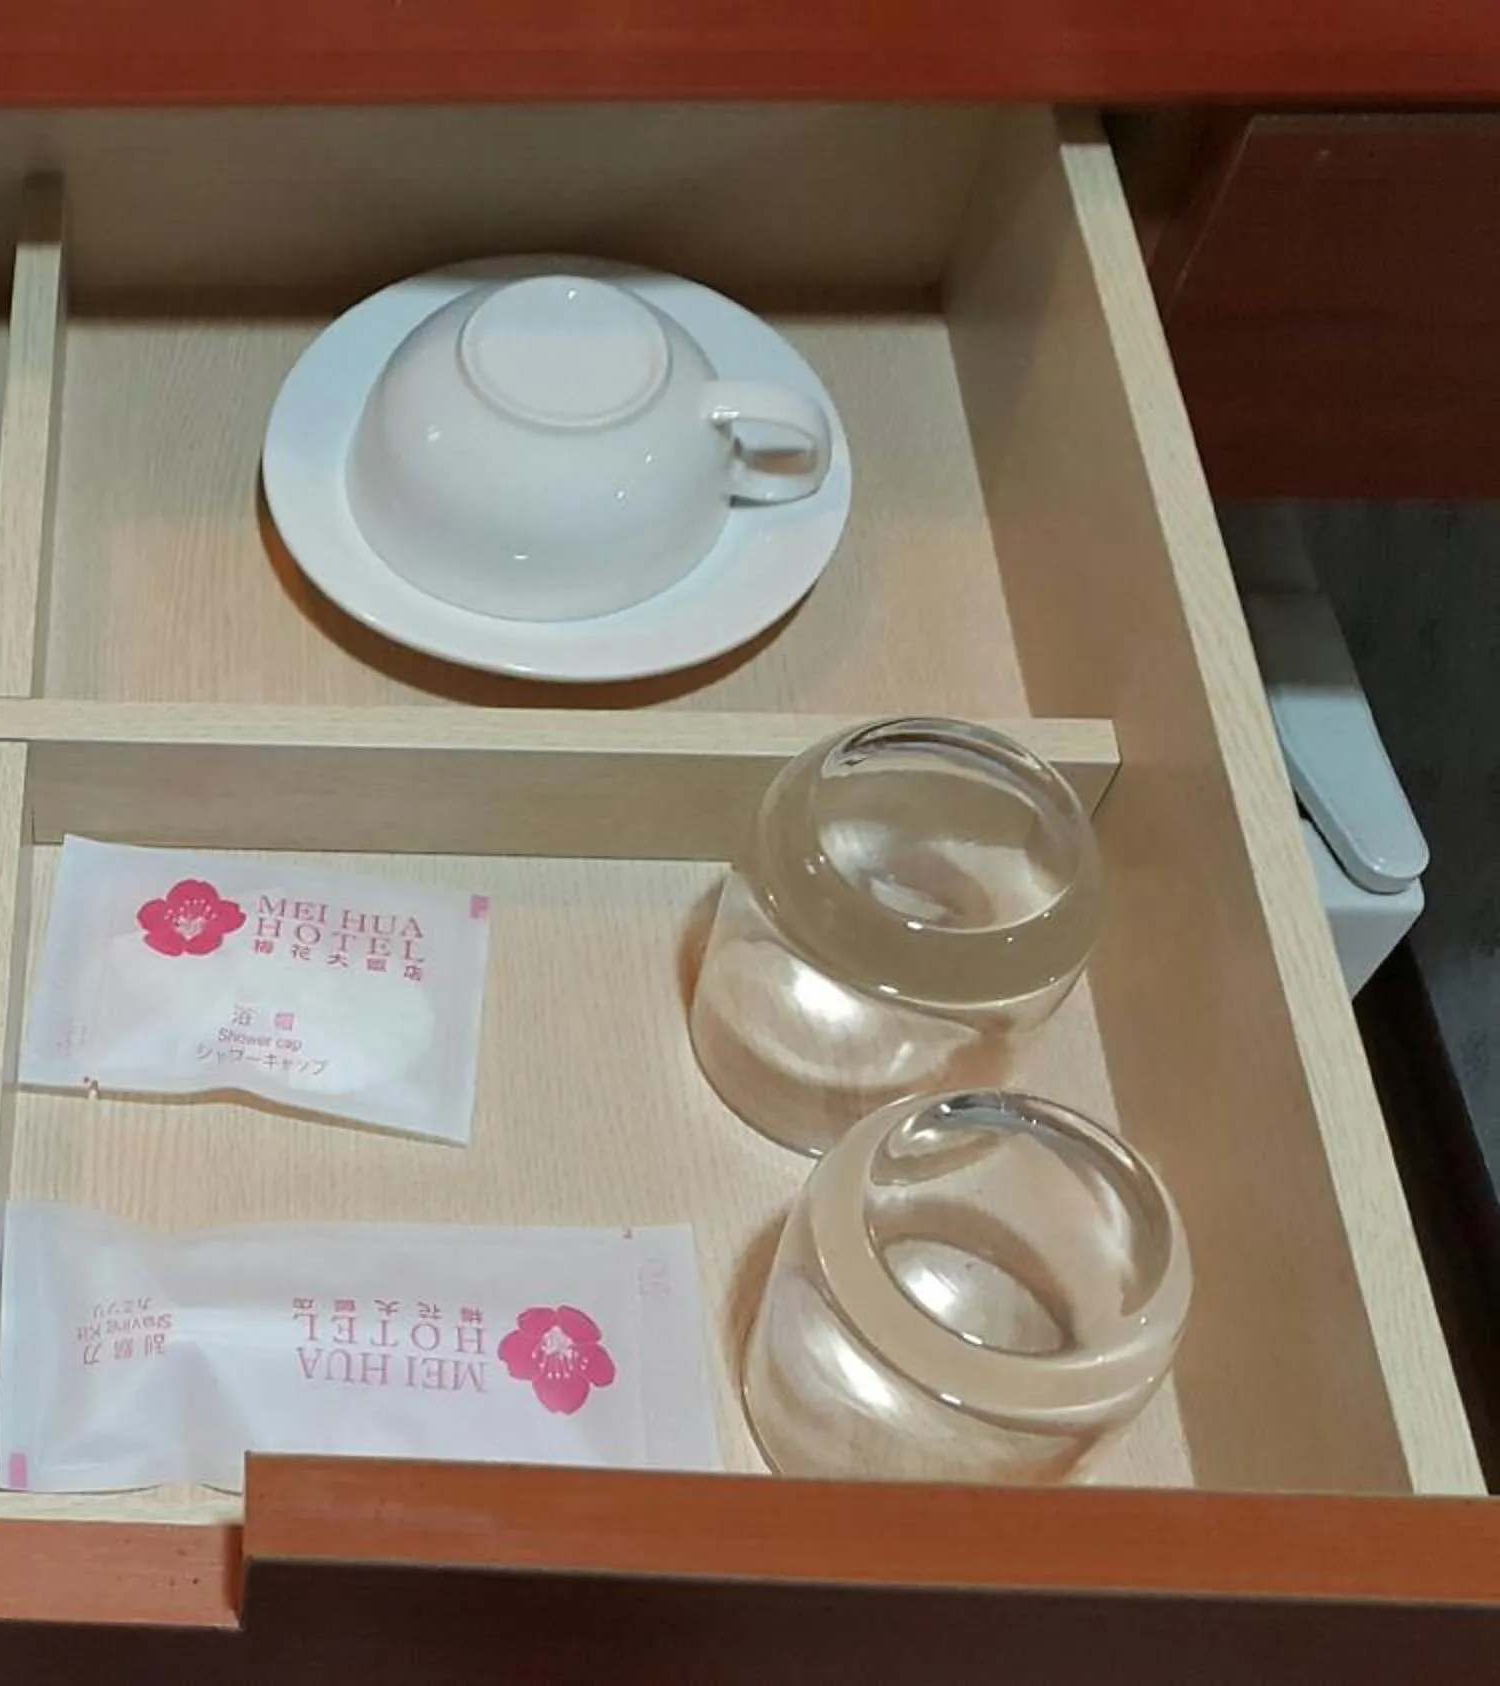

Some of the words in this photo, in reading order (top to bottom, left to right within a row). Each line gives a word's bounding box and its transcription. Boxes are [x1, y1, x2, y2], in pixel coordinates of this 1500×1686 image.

[256, 894, 328, 924] MEI
[342, 909, 424, 939] HUA
[256, 917, 426, 963] HOTEL
[217, 1027, 273, 1047] Shower
[275, 1038, 303, 1053] cap
[293, 1312, 487, 1355] HOTEL
[295, 1346, 393, 1386] HUA
[405, 1354, 490, 1394] MEI
